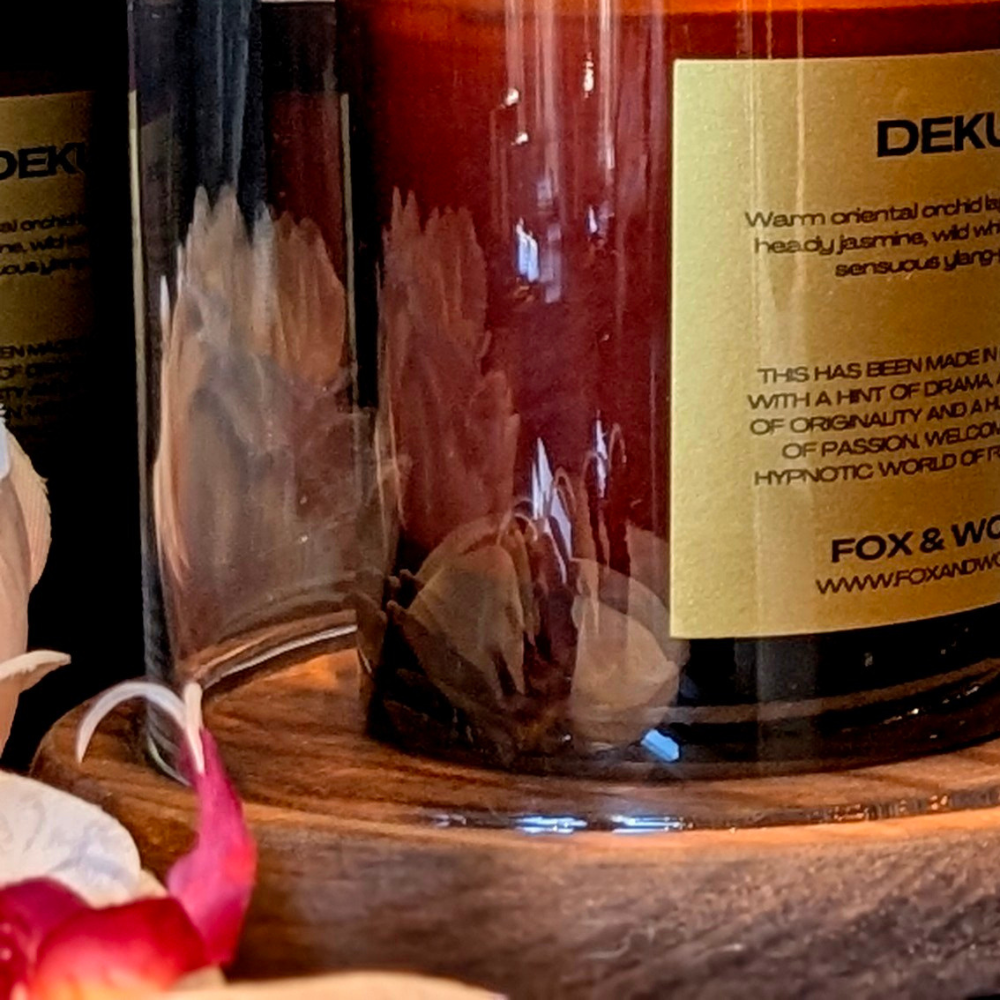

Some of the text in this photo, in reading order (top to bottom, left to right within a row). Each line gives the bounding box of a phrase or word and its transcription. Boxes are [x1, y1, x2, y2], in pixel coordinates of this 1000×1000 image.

[745, 210, 826, 228] Warm
[831, 202, 919, 225] oriental
[922, 195, 983, 218] orchid
[754, 234, 835, 256] heady
[835, 230, 929, 256] jasmine,
[932, 222, 970, 242] wild
[835, 255, 941, 277] sensuous
[757, 366, 810, 384] THIS
[814, 362, 863, 381] HAS
[866, 356, 923, 378] BEEN
[925, 348, 980, 371] MADE
[982, 346, 998, 364] IN
[747, 391, 811, 410] WITH
[815, 390, 832, 407] A
[836, 385, 886, 406] HINT
[889, 381, 921, 401] OF
[749, 417, 786, 436] OF
[790, 406, 923, 434] ORIGINALITY
[926, 401, 967, 422] AND
[970, 399, 983, 415] A
[754, 462, 875, 486] HYPNOTIC
[878, 452, 957, 477] WORLD
[960, 447, 985, 467] OF
[782, 441, 818, 460] OF
[831, 530, 914, 563] FOX
[919, 527, 945, 553] &
